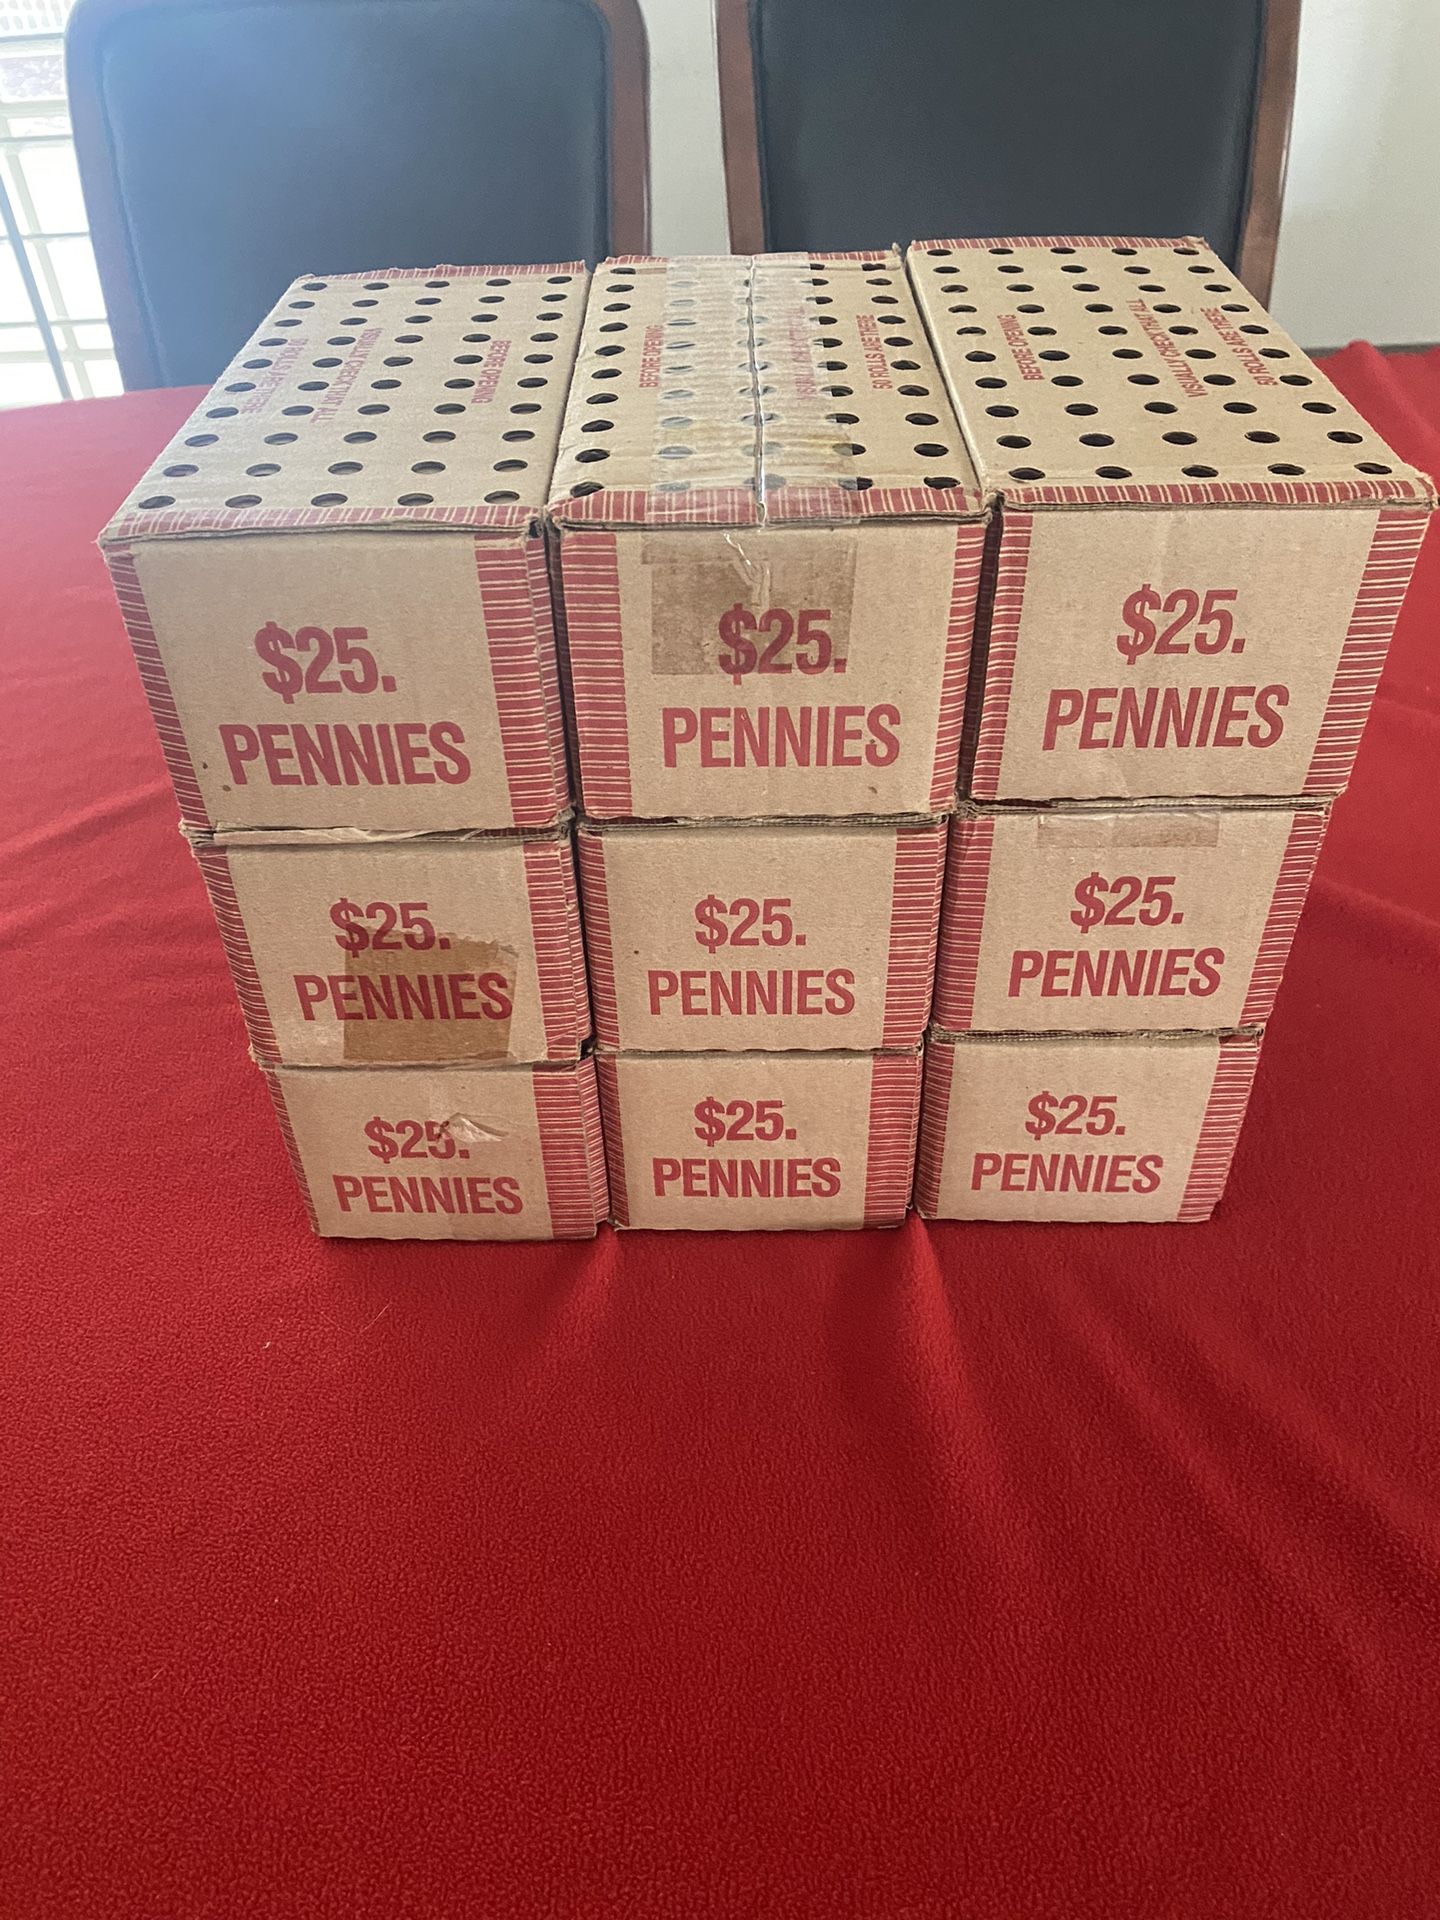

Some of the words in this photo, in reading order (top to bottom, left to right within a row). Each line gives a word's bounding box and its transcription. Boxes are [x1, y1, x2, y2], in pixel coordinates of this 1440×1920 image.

[1126, 299, 1149, 312] ALL
[1134, 313, 1162, 332] THAT
[1200, 307, 1233, 331] THERE
[643, 325, 664, 356] OPENING
[855, 314, 879, 336] THERE
[997, 315, 1028, 346] OPENING
[1218, 331, 1248, 346] ARE
[483, 340, 512, 367] BEFORE
[860, 336, 883, 352] ARE
[1149, 331, 1181, 357] CHECK
[1232, 347, 1270, 374] ROLLS
[638, 357, 661, 388] BEFORE
[864, 353, 890, 378] ROLLS
[1011, 348, 1045, 380] BEFORE
[1164, 357, 1208, 397] VISUALLY
[1254, 375, 1279, 385] 50
[471, 368, 502, 403] OPENING
[872, 379, 893, 389] 50
[310, 407, 339, 424] ALL
[1117, 583, 1246, 664] $25.
[253, 621, 397, 703] $25.
[717, 602, 847, 685] $25.
[662, 703, 901, 769] PENNIES
[1041, 684, 1289, 751] PENNIES
[218, 722, 472, 786] PENNIES
[1070, 872, 1184, 934] $25.
[329, 897, 450, 957] $25.
[694, 894, 806, 955] $25.
[1007, 947, 1225, 998] PENNIES
[293, 972, 513, 1022] PENNIES
[647, 968, 855, 1016] PENNIES
[694, 1096, 797, 1147] $25.
[1025, 1091, 1126, 1141] $25.
[652, 1157, 841, 1199] PENNIES
[970, 1152, 1163, 1194] PENNIES
[333, 1174, 523, 1215] PENNIES
